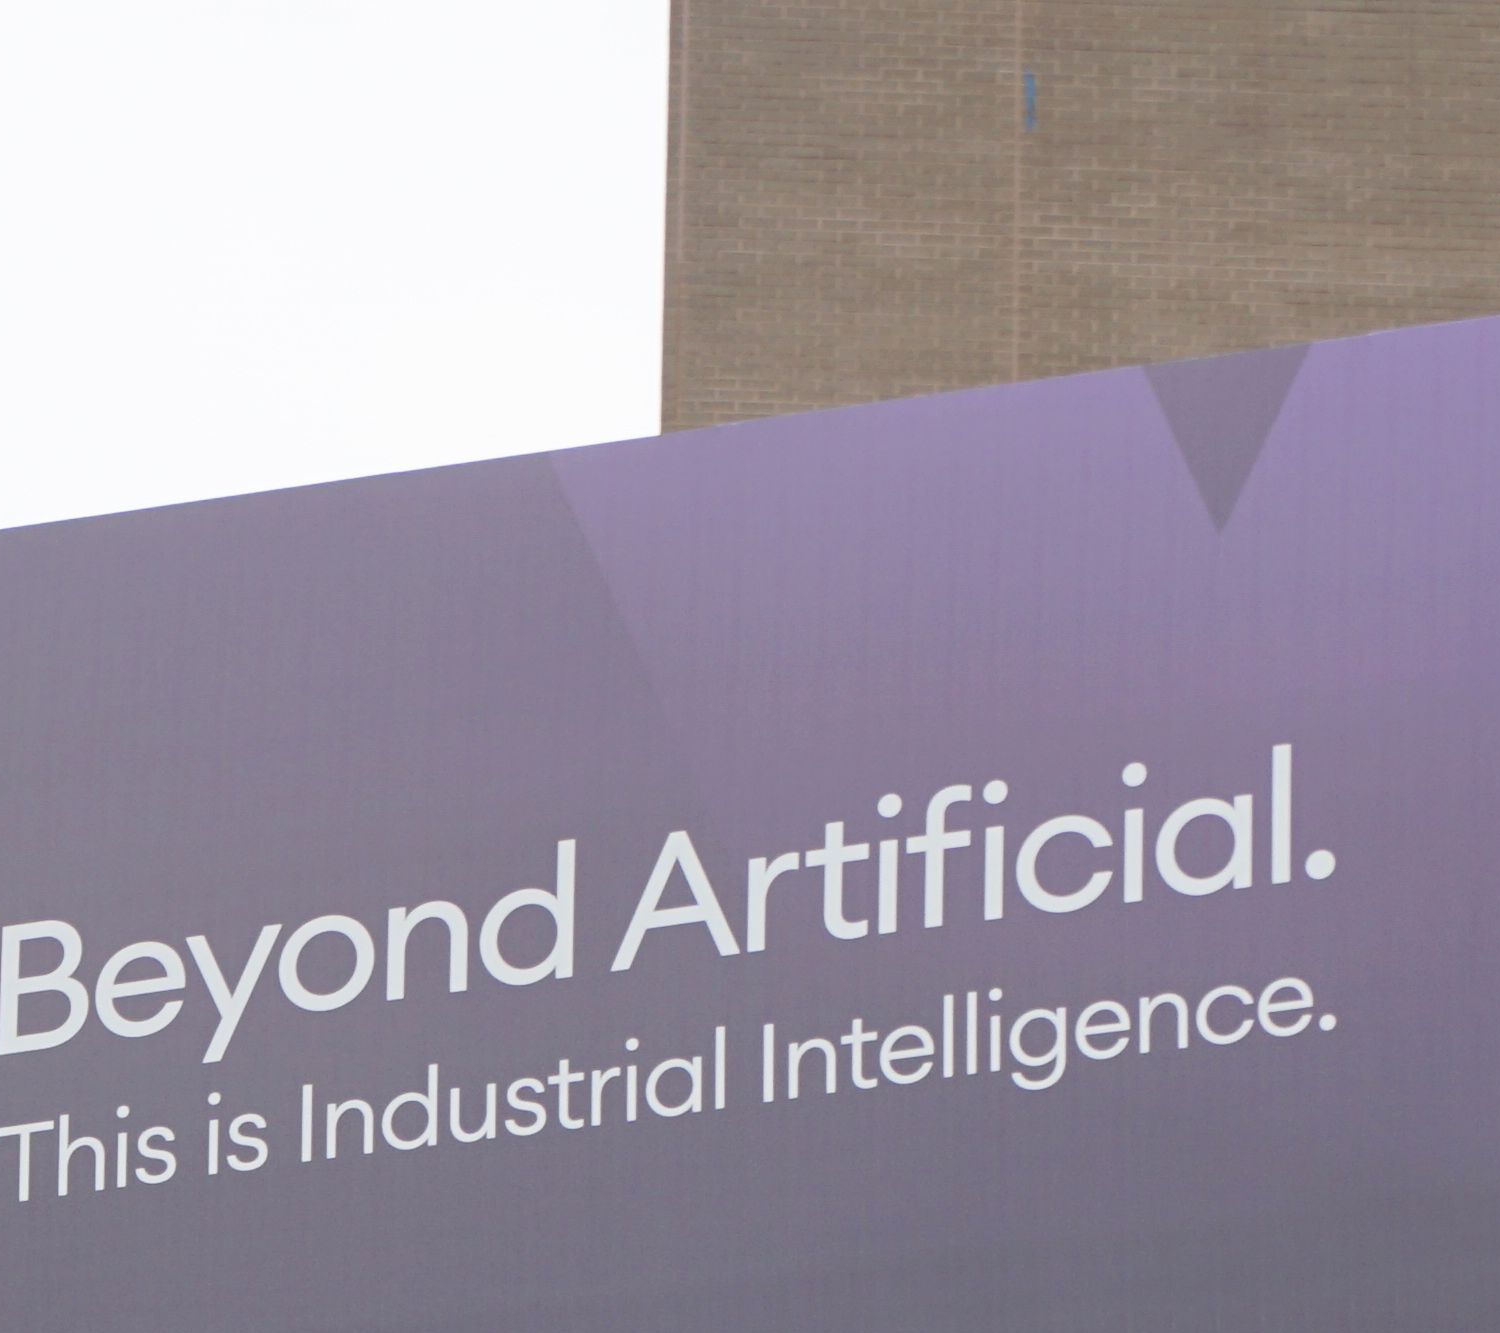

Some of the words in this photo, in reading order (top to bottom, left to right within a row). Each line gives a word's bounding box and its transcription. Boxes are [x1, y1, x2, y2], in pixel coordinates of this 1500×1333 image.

[610, 743, 1337, 972] Artificial.
[206, 1091, 270, 1176] is
[300, 1025, 727, 1164] Industrial
[762, 977, 1338, 1103] Intelligence.
